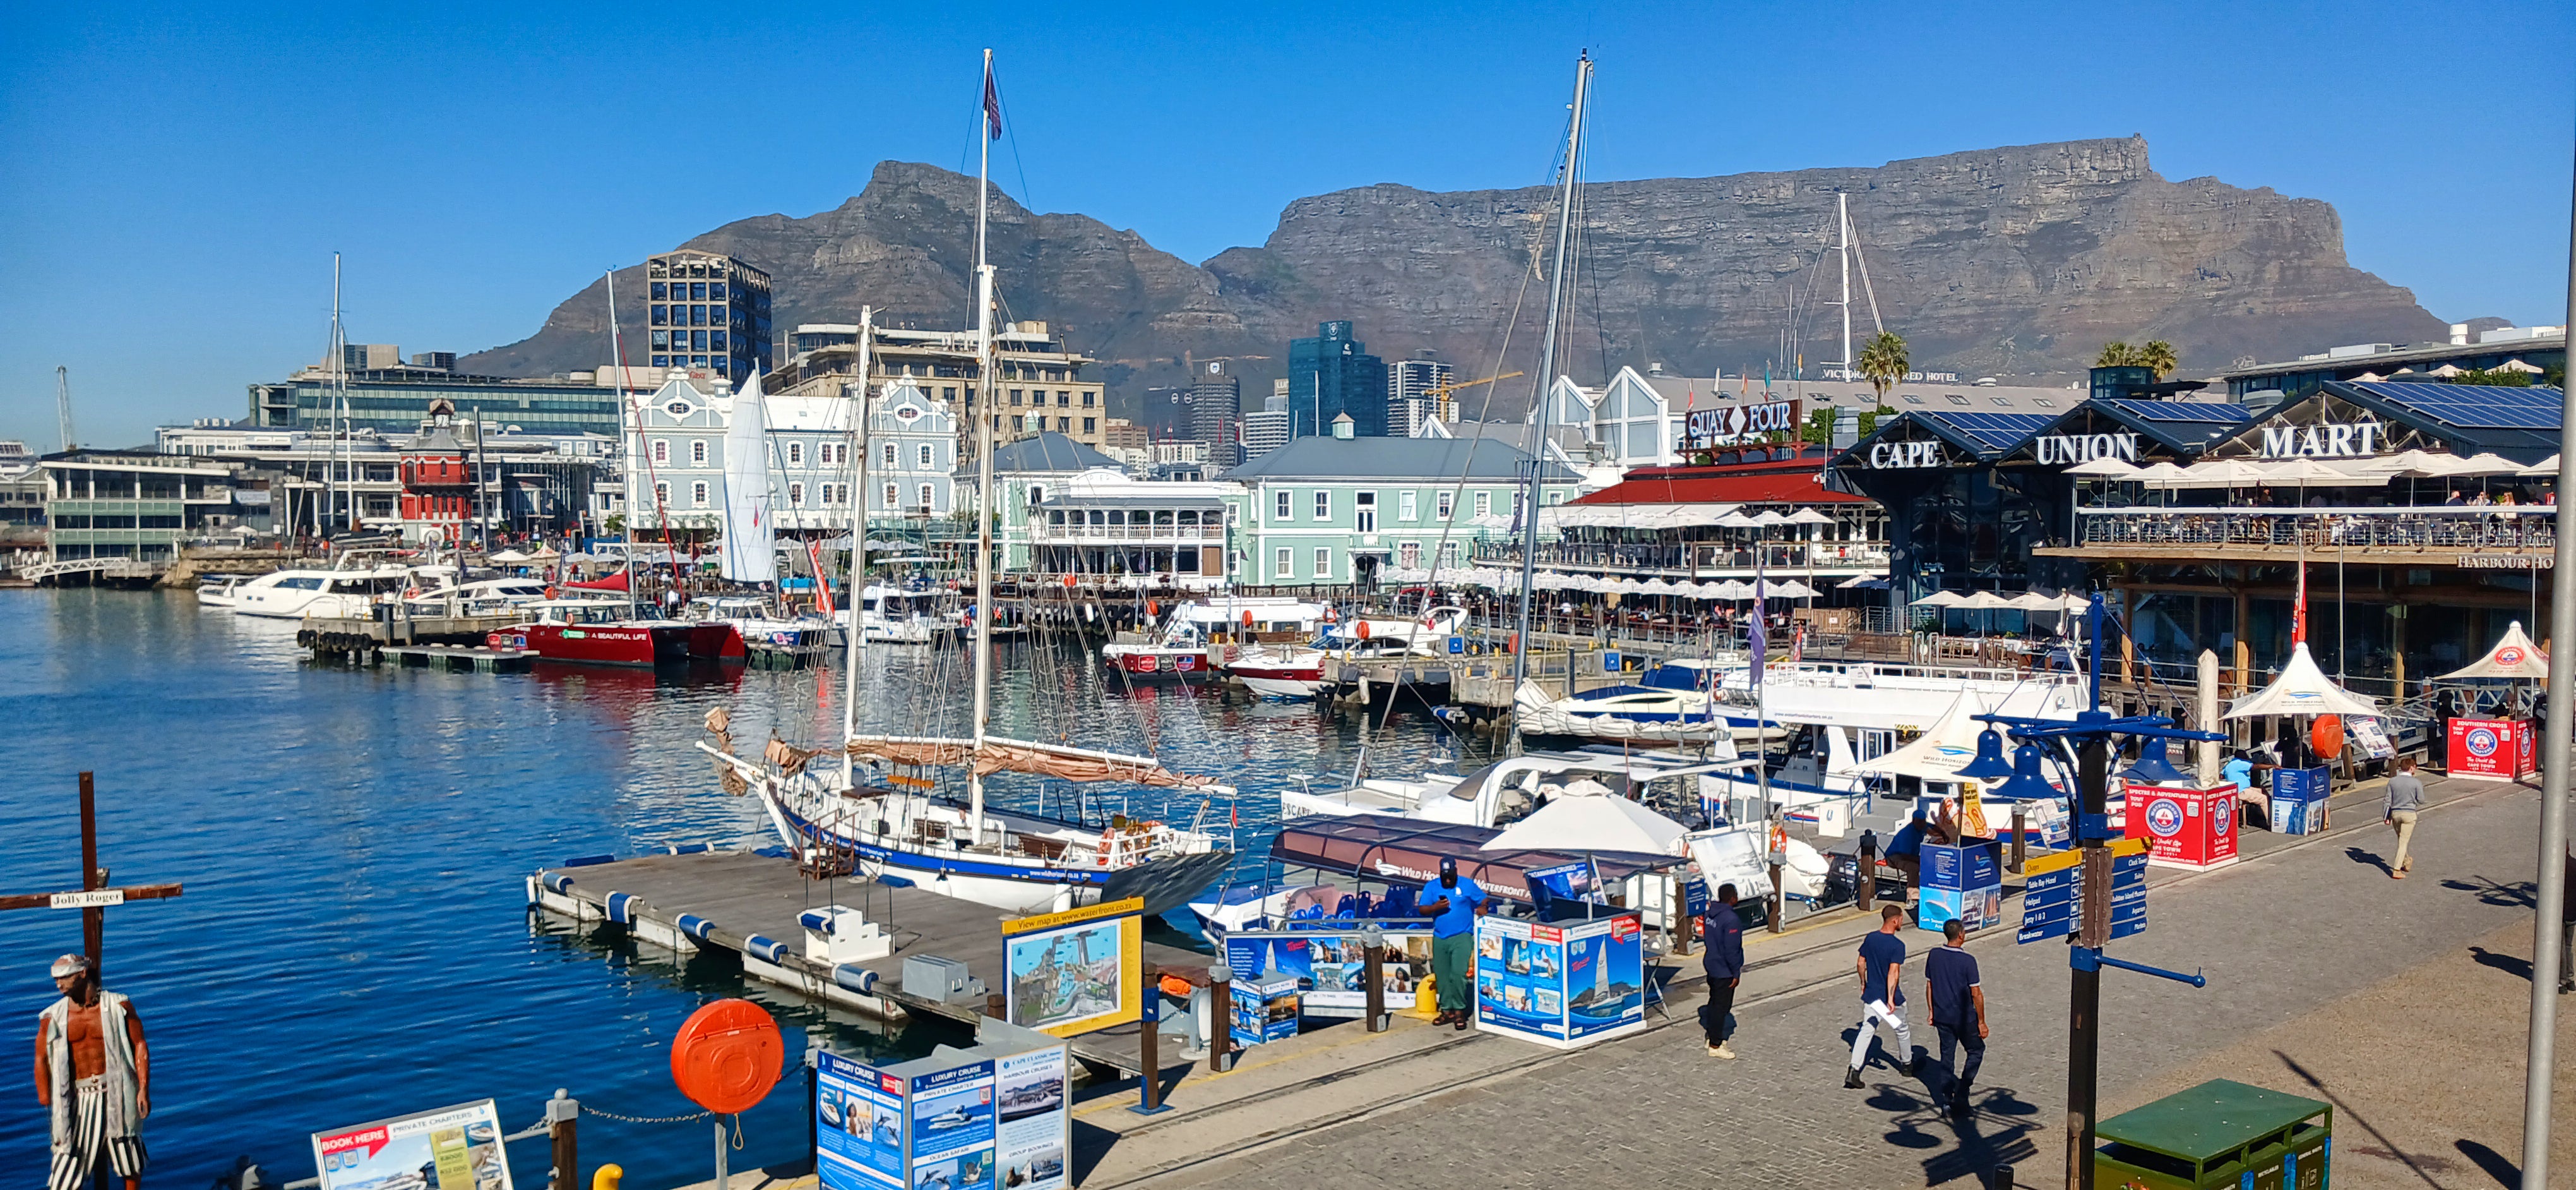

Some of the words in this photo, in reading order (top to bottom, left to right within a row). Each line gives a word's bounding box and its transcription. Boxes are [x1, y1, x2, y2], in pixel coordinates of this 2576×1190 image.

[1926, 372, 1959, 382] HOTEL
[1689, 408, 1728, 437] QUAY
[1748, 402, 1792, 433] FOUR
[1871, 440, 1941, 470] CAPE
[2036, 433, 2140, 466] UNION
[2260, 422, 2383, 459] MART
[2457, 556, 2529, 568] HARBOUR
[2157, 790, 2189, 799] ADVENTURE
[2150, 820, 2178, 833] CHARTERS
[1402, 866, 1422, 879] WILD
[53, 895, 81, 906] Jolly
[86, 892, 121, 903] Roger
[1018, 920, 1035, 930] View
[1037, 918, 1051, 929] map
[1061, 903, 1132, 922] www.waterfront.co.za
[2018, 930, 2043, 941] Breakwater
[833, 1058, 855, 1074] LUXURY
[854, 1066, 876, 1081] CRUISE
[931, 1070, 958, 1083] LUXURY
[958, 1065, 982, 1076] CRUISE
[924, 1089, 947, 1097] PRIVATE
[322, 1136, 354, 1151] BOOK
[355, 1130, 386, 1145] HERE
[392, 1120, 427, 1133] PRIVATE
[429, 1111, 474, 1127] CHARTERS
[929, 1151, 949, 1161] OCEAN
